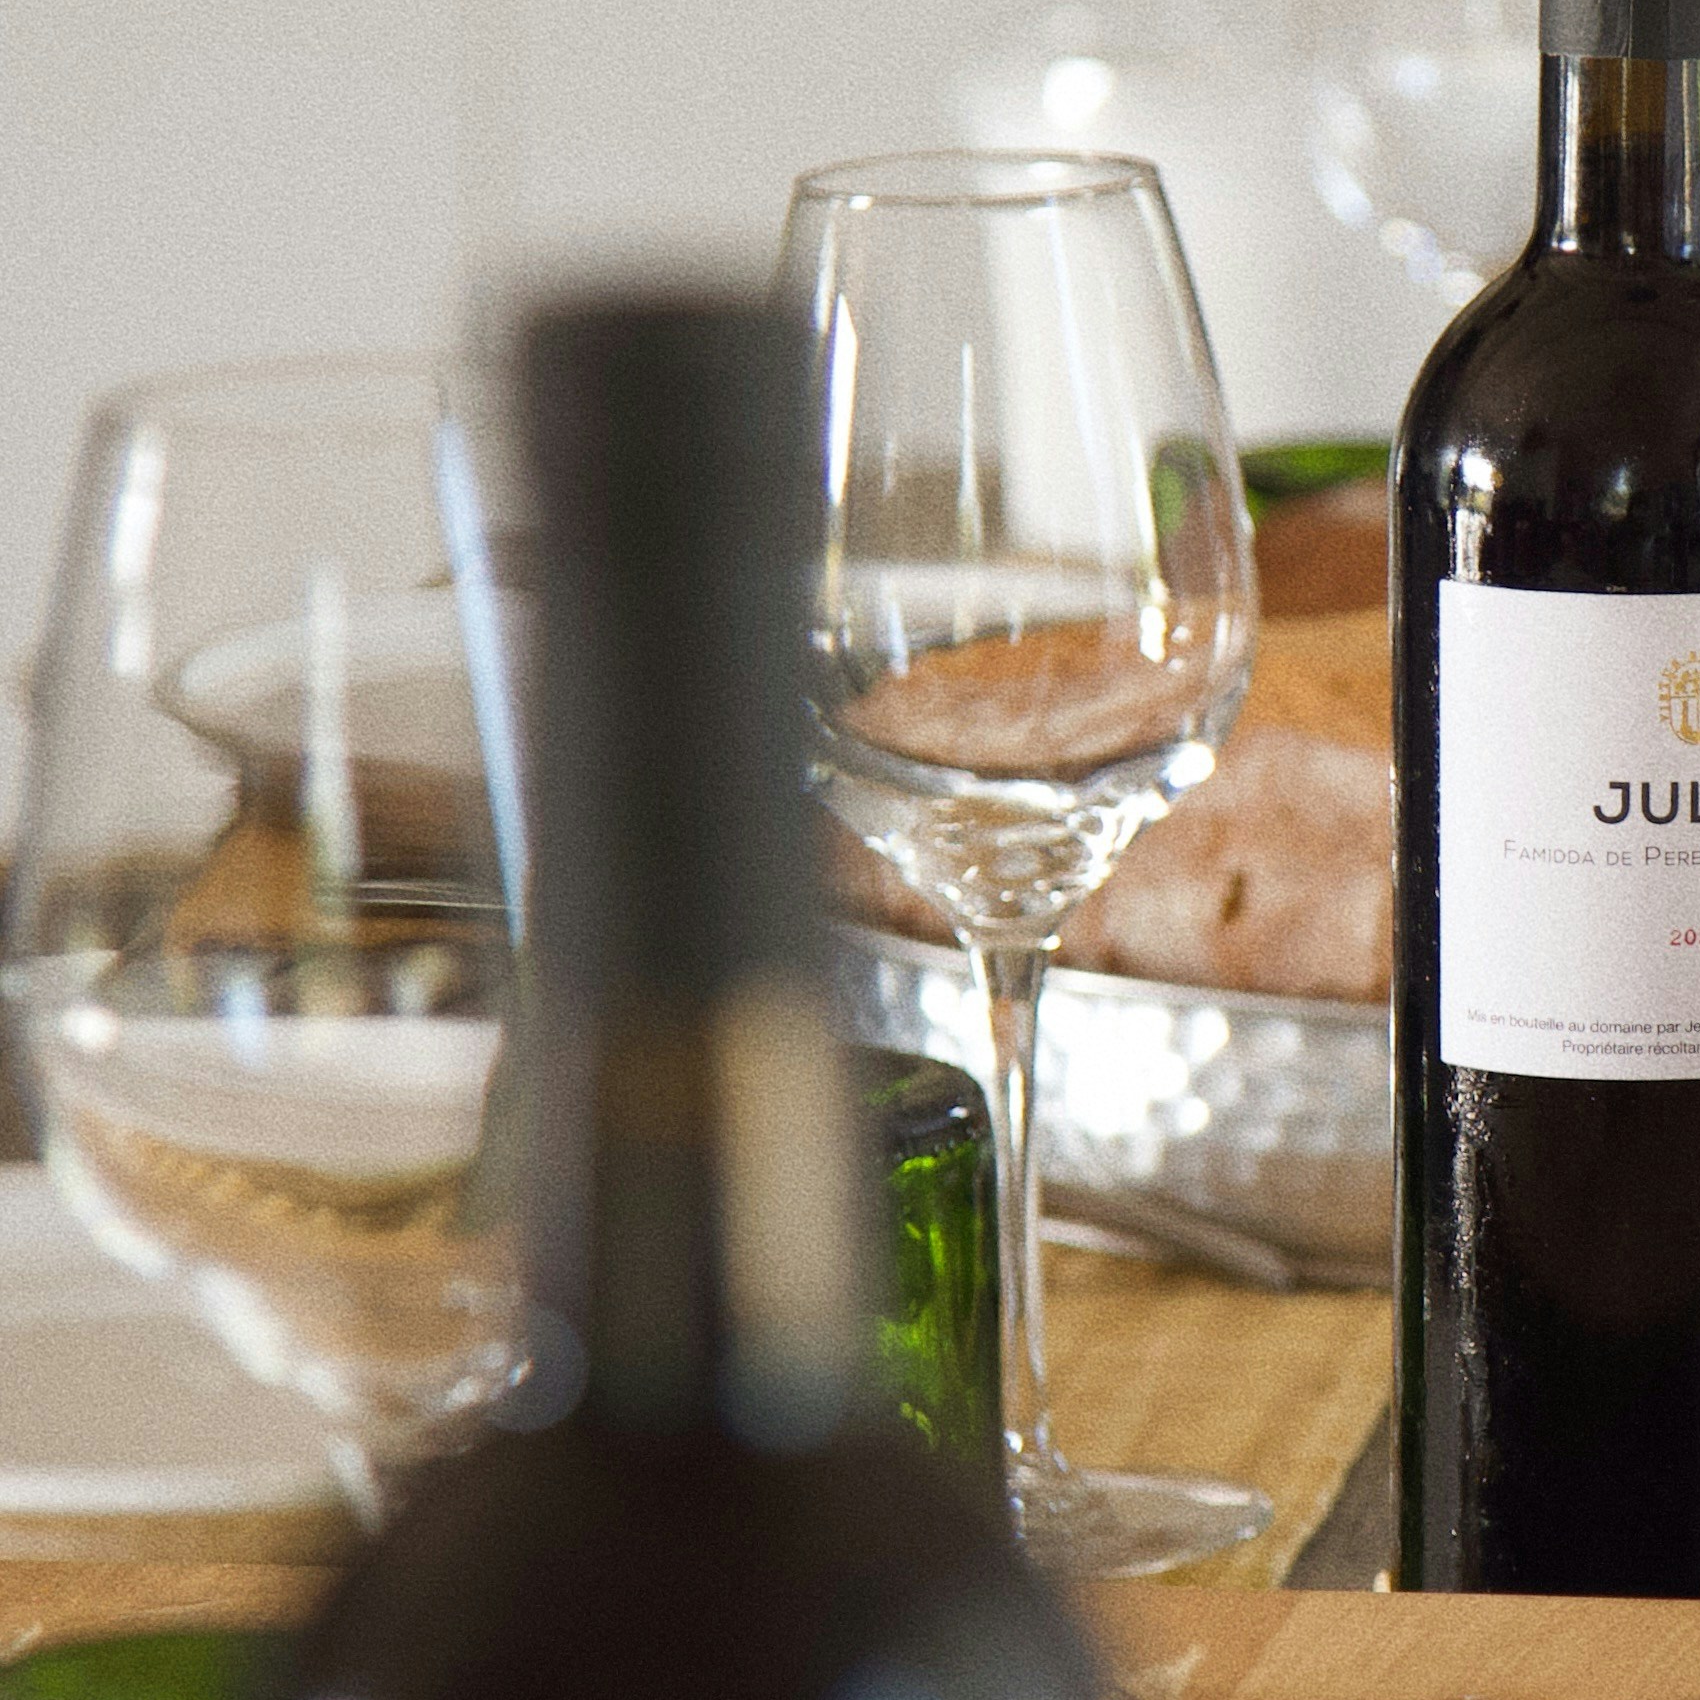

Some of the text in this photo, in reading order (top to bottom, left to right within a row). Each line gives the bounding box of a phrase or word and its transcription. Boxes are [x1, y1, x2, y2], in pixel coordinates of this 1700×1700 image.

[1490, 1014, 1506, 1025] en
[1509, 1013, 1565, 1031] bouteille
[1568, 1022, 1586, 1033] au
[1590, 1018, 1653, 1034] domaine
[1656, 1022, 1682, 1038] par
[1561, 1039, 1643, 1057] Propriétaire
